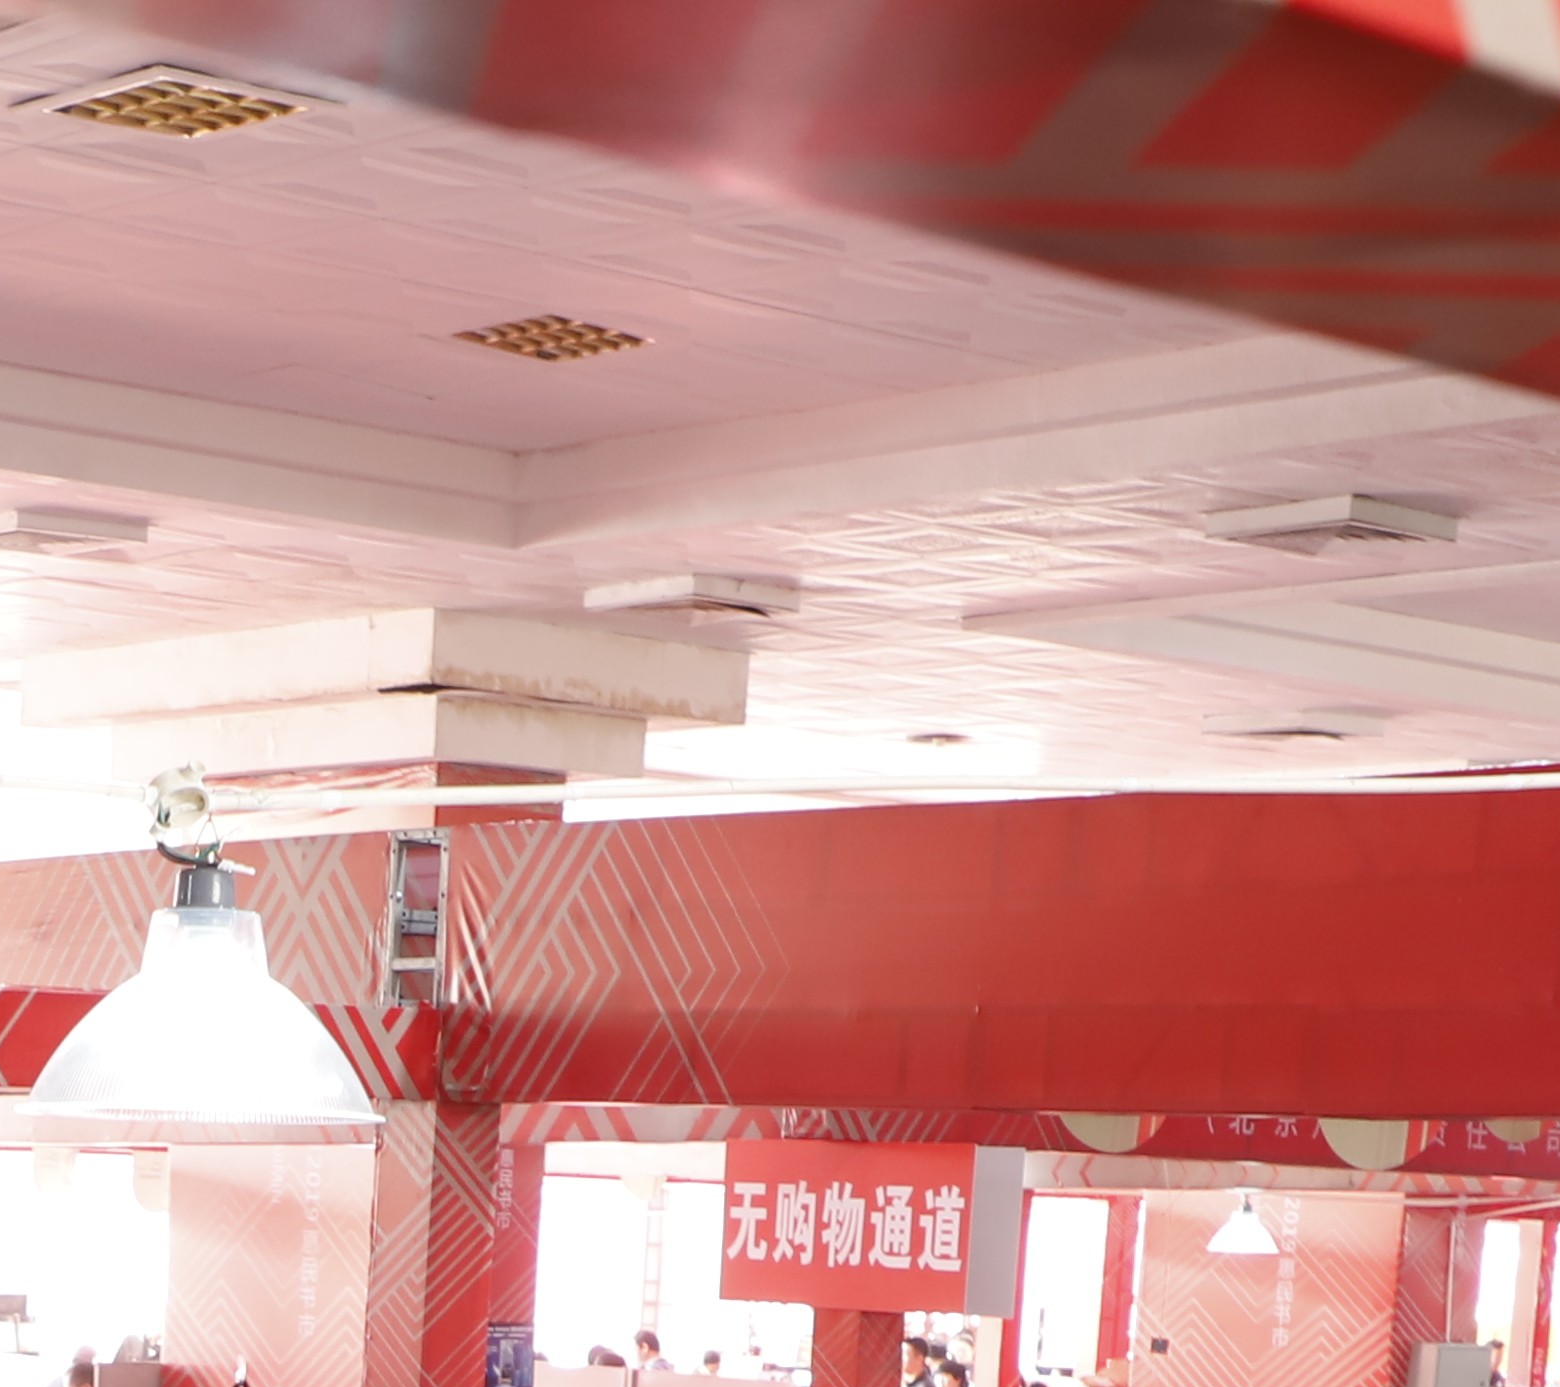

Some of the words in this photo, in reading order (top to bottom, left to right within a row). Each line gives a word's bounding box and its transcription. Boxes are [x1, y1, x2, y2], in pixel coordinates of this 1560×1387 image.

[726, 1180, 965, 1273] 无购物通道
